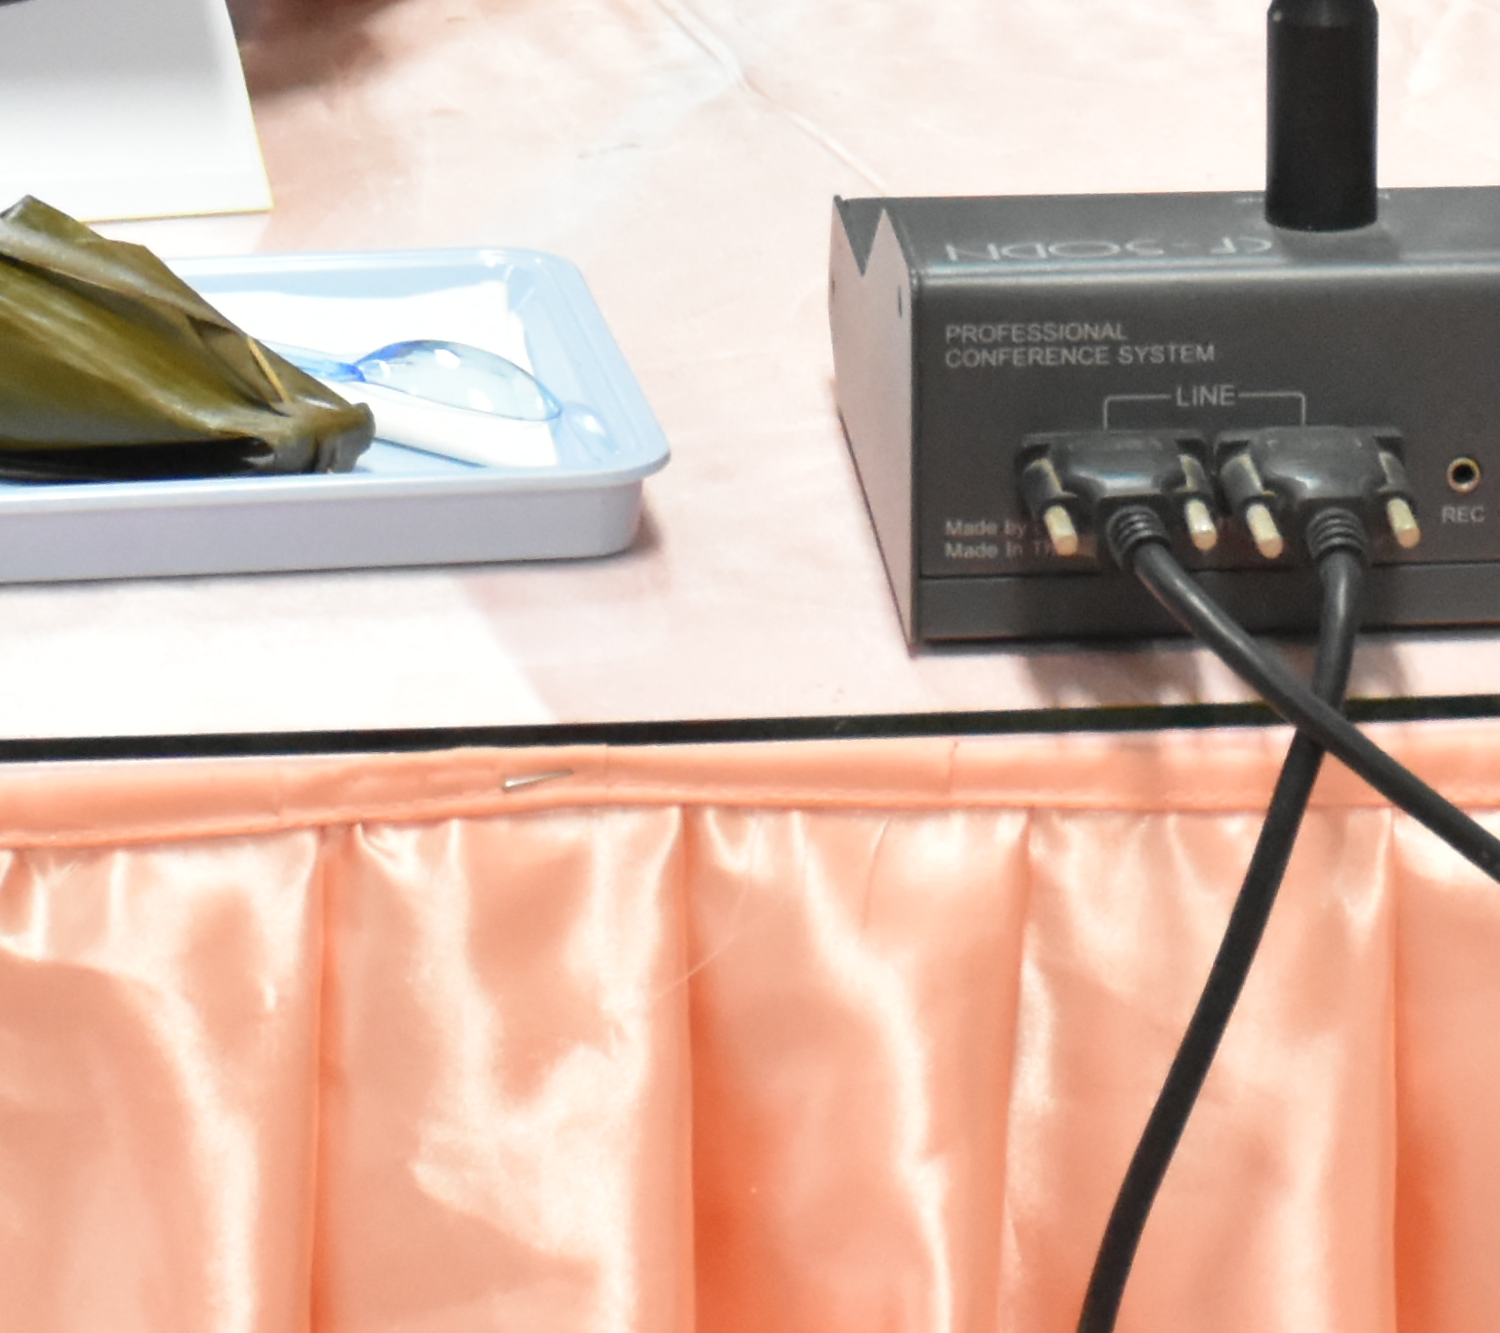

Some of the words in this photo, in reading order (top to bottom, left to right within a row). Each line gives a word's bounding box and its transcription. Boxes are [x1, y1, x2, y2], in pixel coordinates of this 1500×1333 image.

[945, 322, 1129, 343] PROFESSIONAL
[945, 345, 1111, 368] CONFERENCE
[1117, 343, 1216, 365] SYSTEM
[1175, 384, 1237, 407] LINE
[1441, 506, 1485, 523] REC
[944, 519, 998, 536] Made
[944, 541, 999, 558] Made
